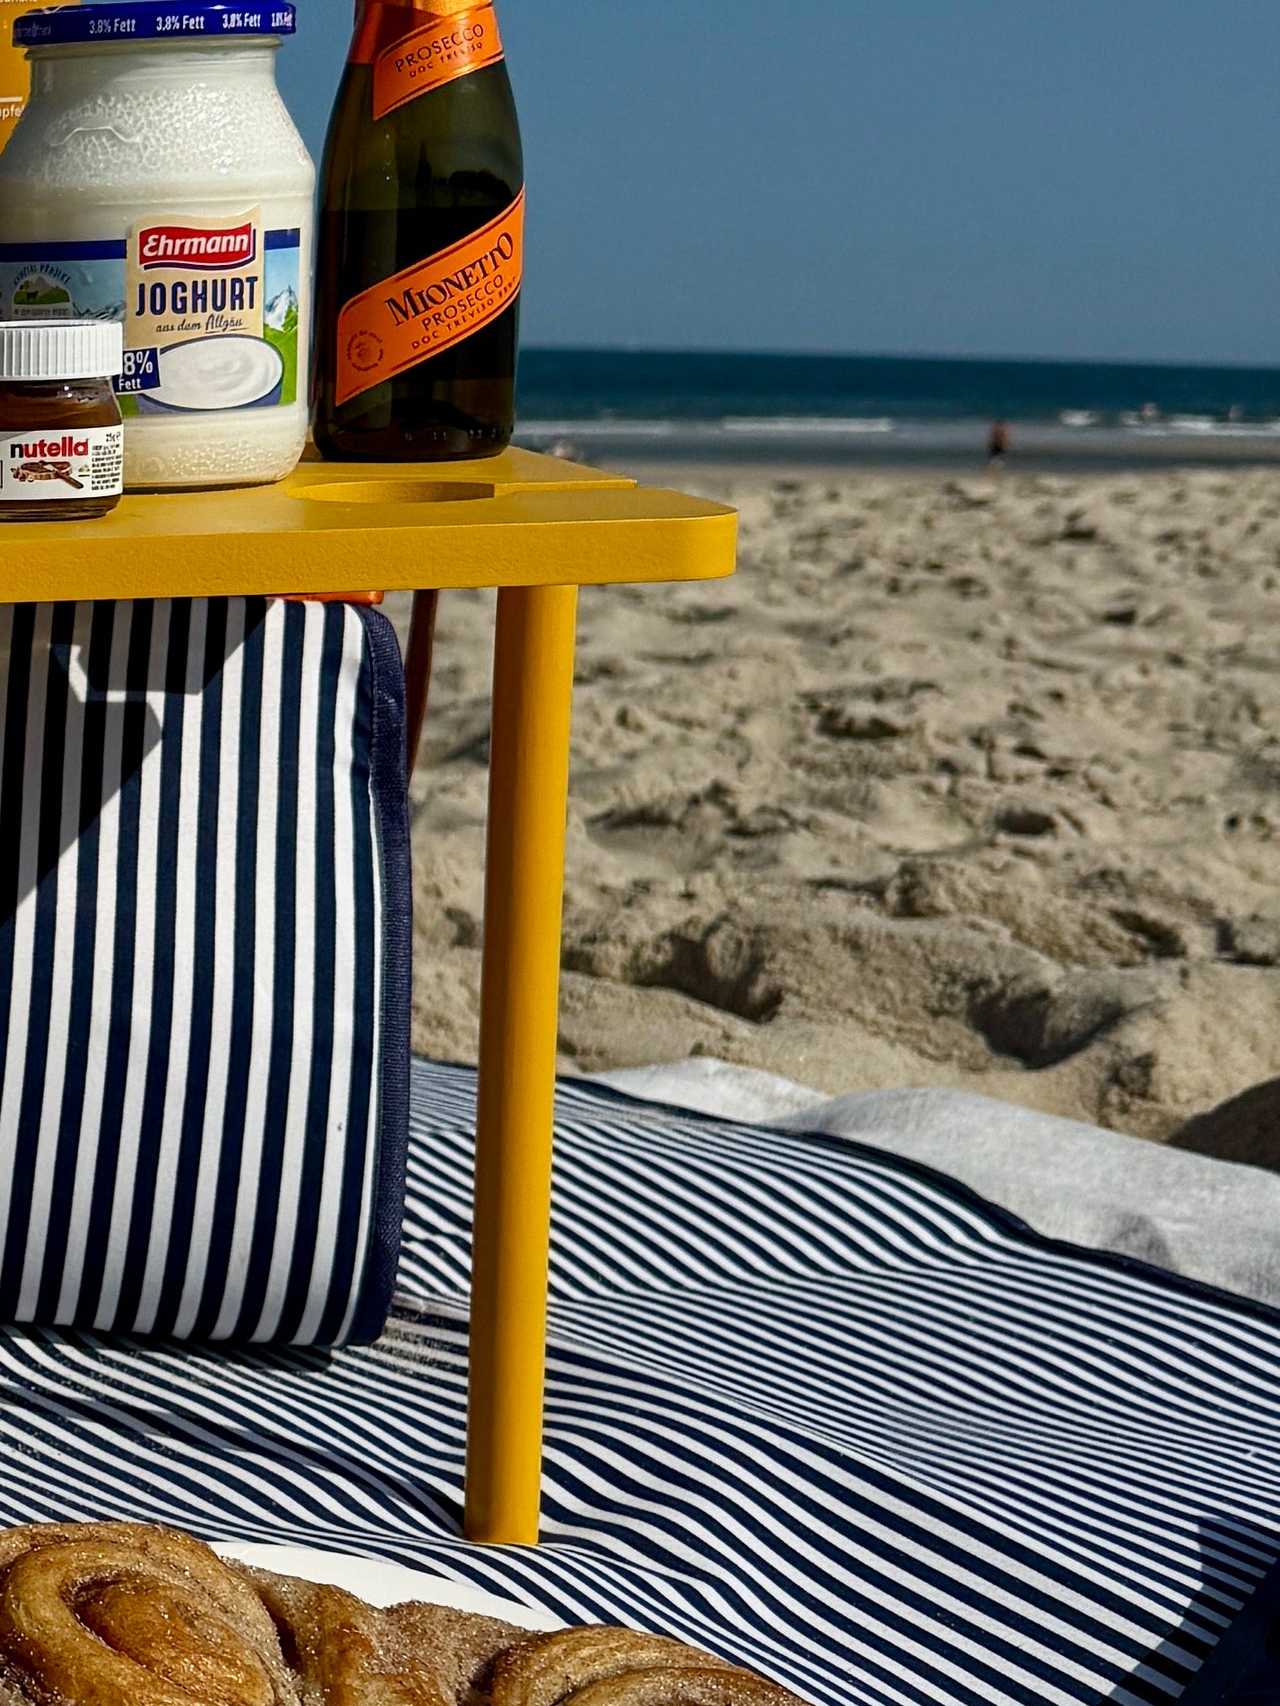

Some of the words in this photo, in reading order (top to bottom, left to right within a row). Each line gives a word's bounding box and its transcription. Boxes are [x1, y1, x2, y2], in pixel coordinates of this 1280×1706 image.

[89, 19, 111, 34] 3.8%
[113, 18, 137, 33] Fett
[182, 14, 205, 30] Fett
[243, 12, 261, 28] Fett
[394, 23, 484, 73] PROSECCO
[142, 233, 249, 258] Ehrmann
[135, 276, 259, 317] JOGHURT
[421, 274, 504, 332] PROSECCO
[411, 330, 440, 350] DOC
[118, 377, 142, 392] Fett
[10, 435, 89, 459] nutella
